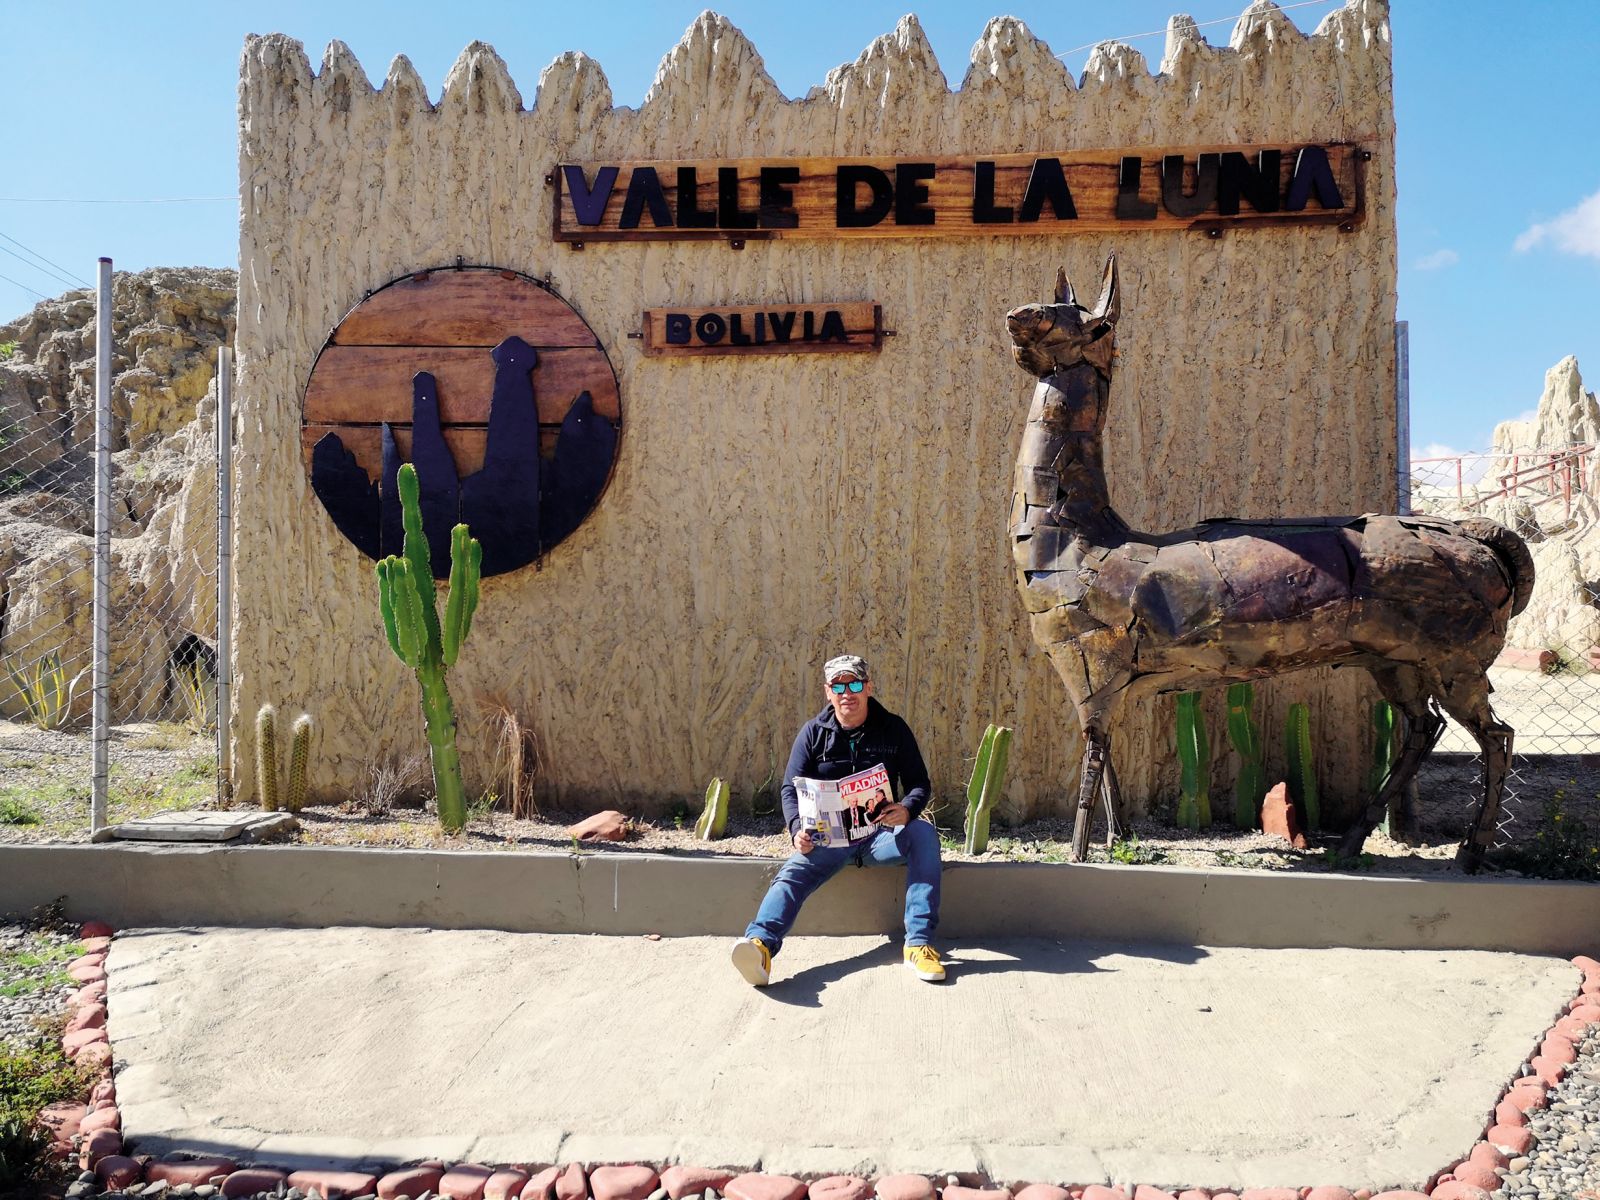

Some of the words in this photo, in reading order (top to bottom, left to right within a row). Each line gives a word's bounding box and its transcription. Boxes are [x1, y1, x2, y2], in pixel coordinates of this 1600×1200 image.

[561, 165, 800, 229] VALLE
[836, 163, 936, 228] DE
[973, 158, 1078, 224] LA
[1115, 146, 1345, 220] LUNA
[665, 310, 848, 345] BOLIVIA
[840, 771, 889, 796] MLADINA
